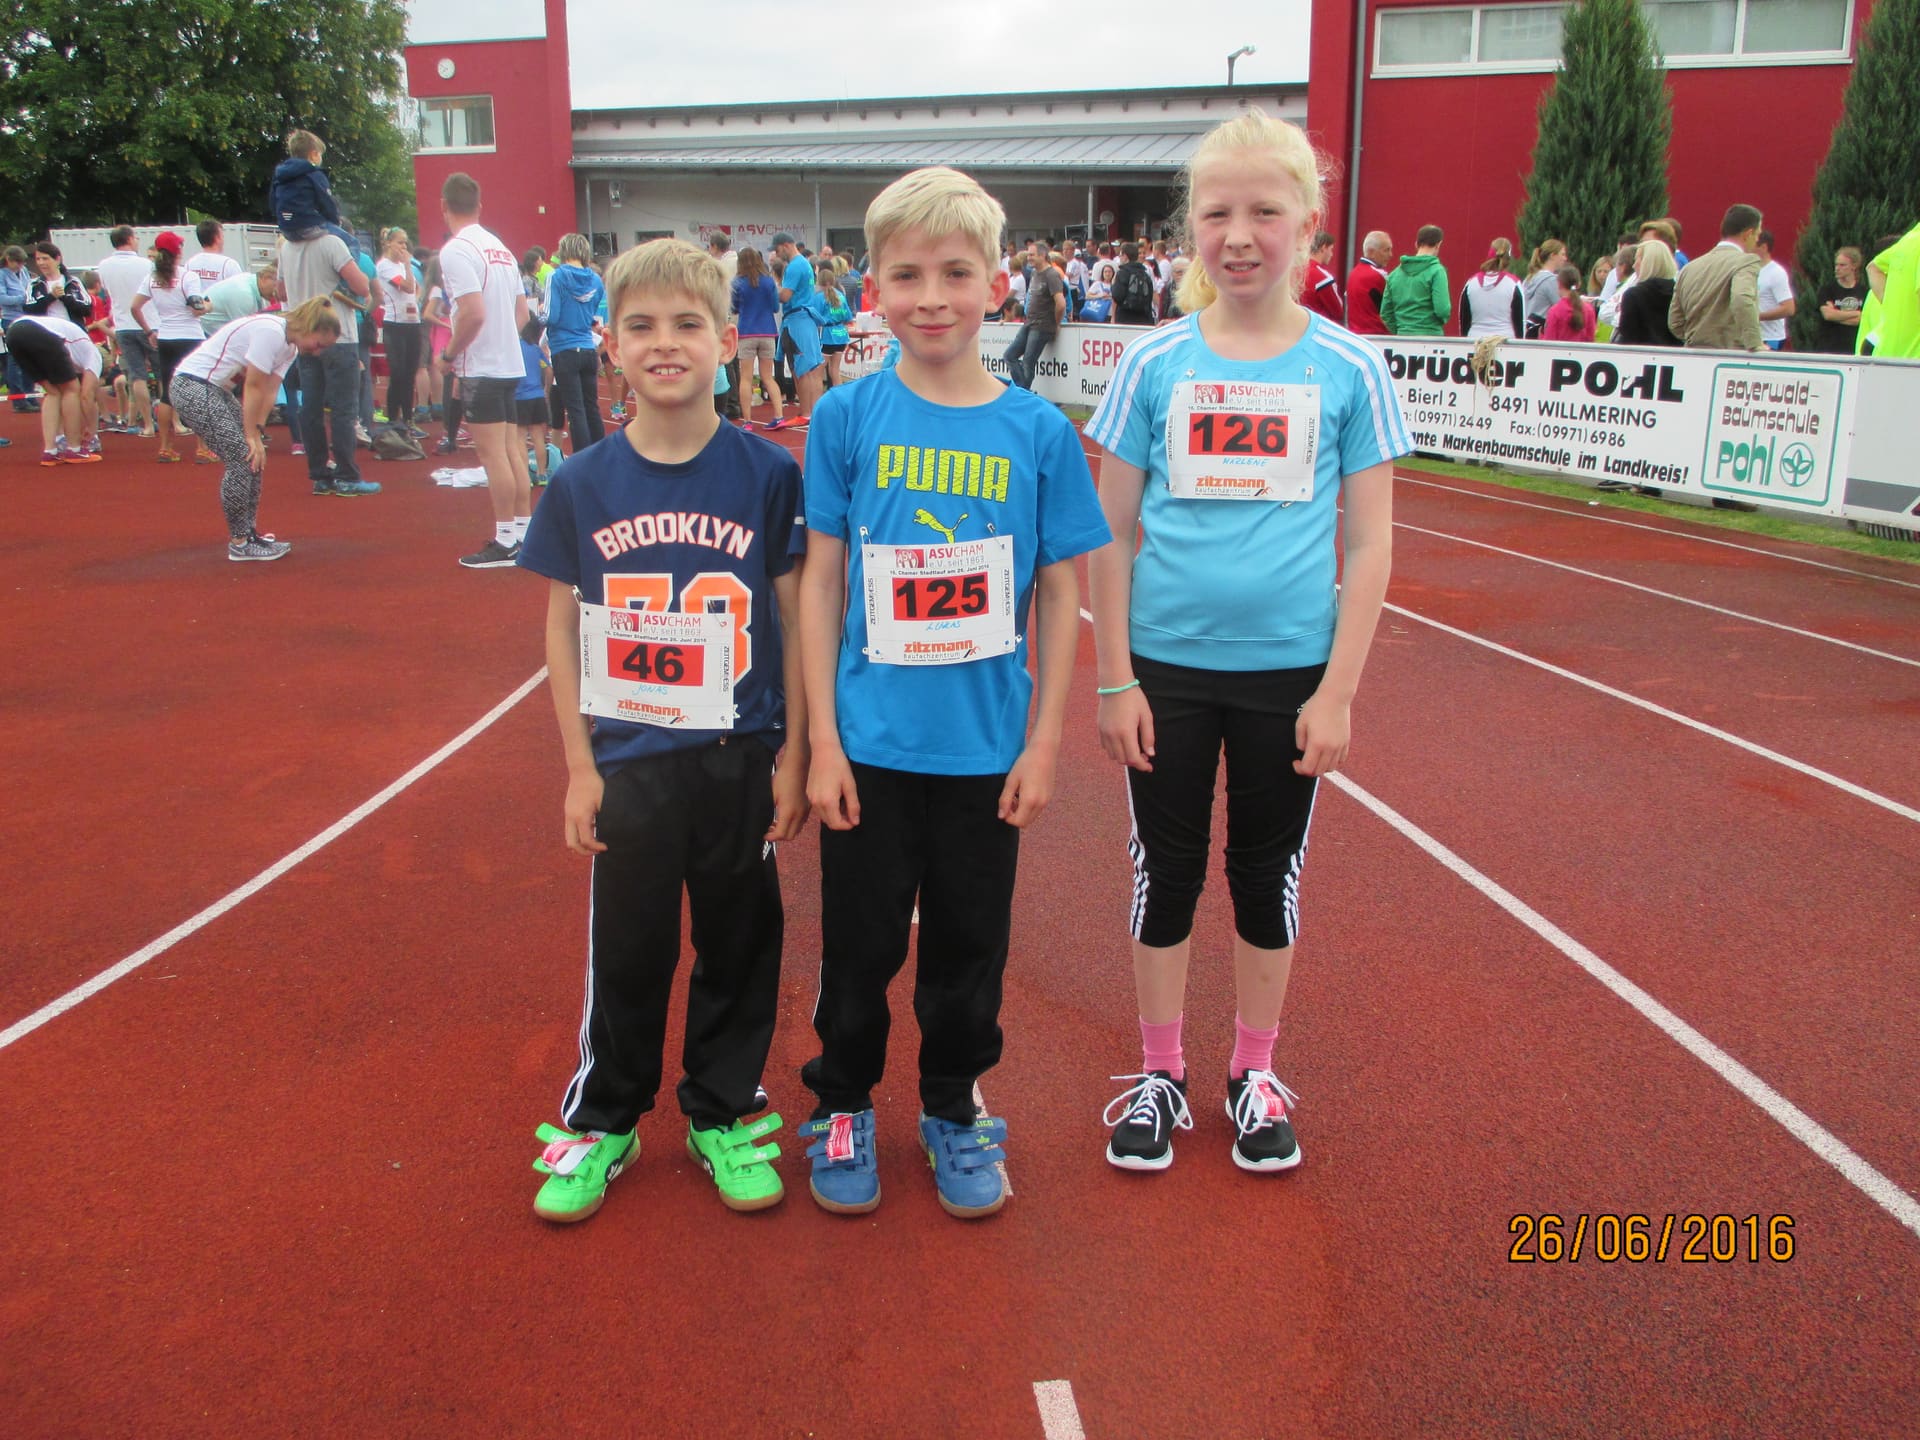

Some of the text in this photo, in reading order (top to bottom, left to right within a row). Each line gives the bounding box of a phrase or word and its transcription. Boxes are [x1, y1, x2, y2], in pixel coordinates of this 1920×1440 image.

[1408, 388, 1457, 407] Bierl 2
[1491, 395, 1657, 429] 8491 WILLMERING
[1193, 414, 1286, 453] 126
[876, 444, 1011, 503] PUMA
[1443, 433, 1570, 466] Markenbaumschule
[1577, 451, 1597, 470] im
[1603, 455, 1689, 484] Landkreis!
[1196, 476, 1265, 488] zitzmann
[592, 512, 754, 560] BROOKLYN
[897, 575, 987, 618] 125
[622, 643, 684, 683] 46
[904, 640, 973, 653] zitzmann
[617, 699, 681, 716] zitzmann
